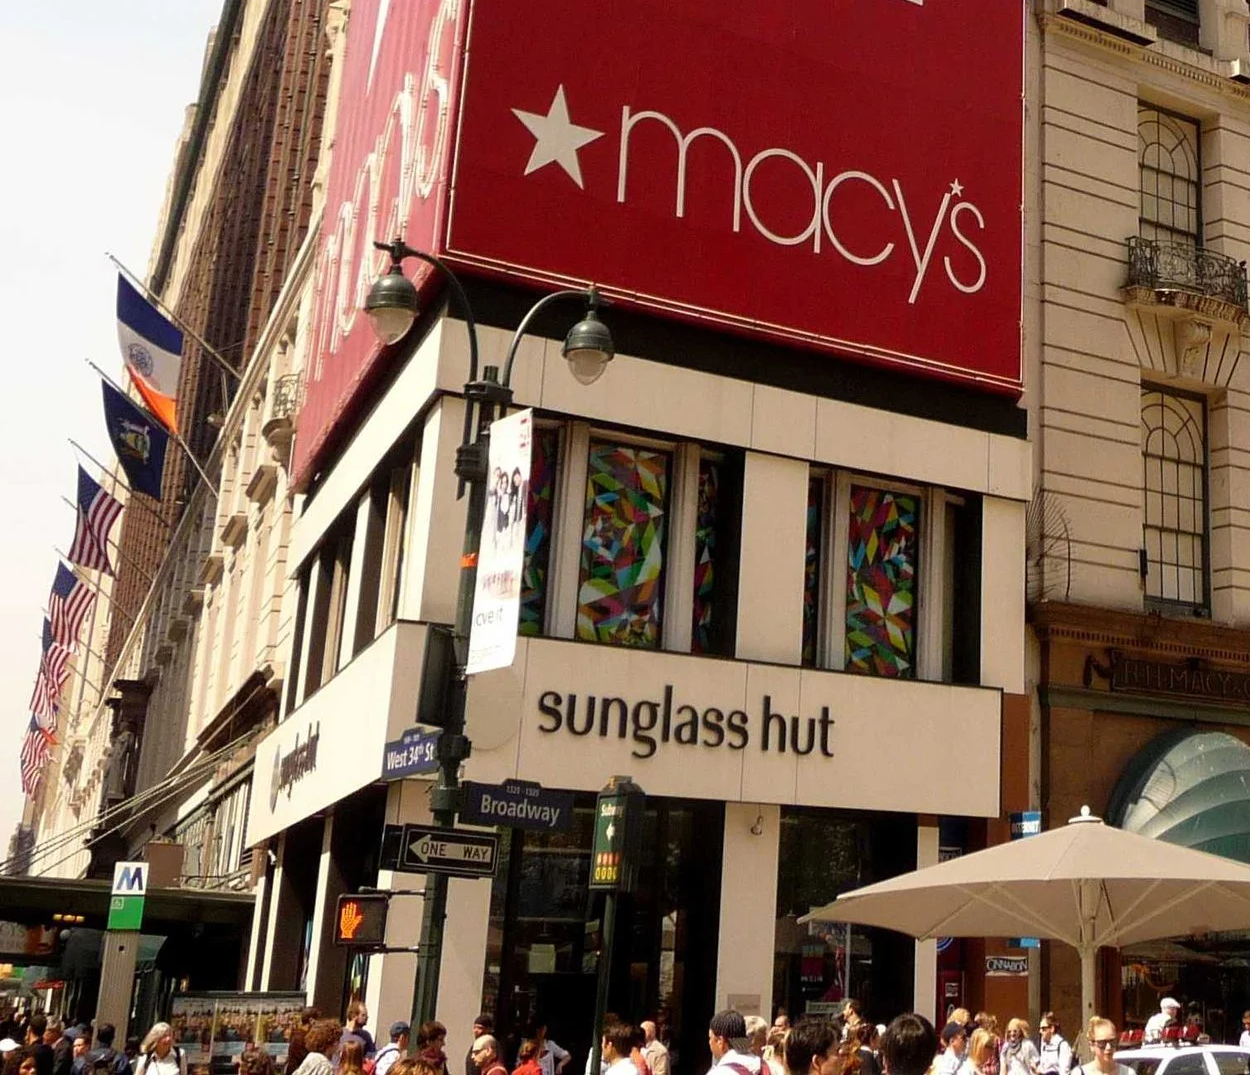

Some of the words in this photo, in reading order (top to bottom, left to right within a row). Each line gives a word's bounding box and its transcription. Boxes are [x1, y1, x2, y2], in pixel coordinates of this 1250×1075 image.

[537, 685, 749, 759] sunglass
[761, 695, 835, 758] hut
[387, 749, 408, 770] West
[408, 742, 424, 766] 34th
[424, 741, 434, 762] St
[480, 794, 560, 827] Broadway
[420, 841, 447, 857] ONE
[463, 846, 490, 862] WAY
[116, 866, 144, 891] M
